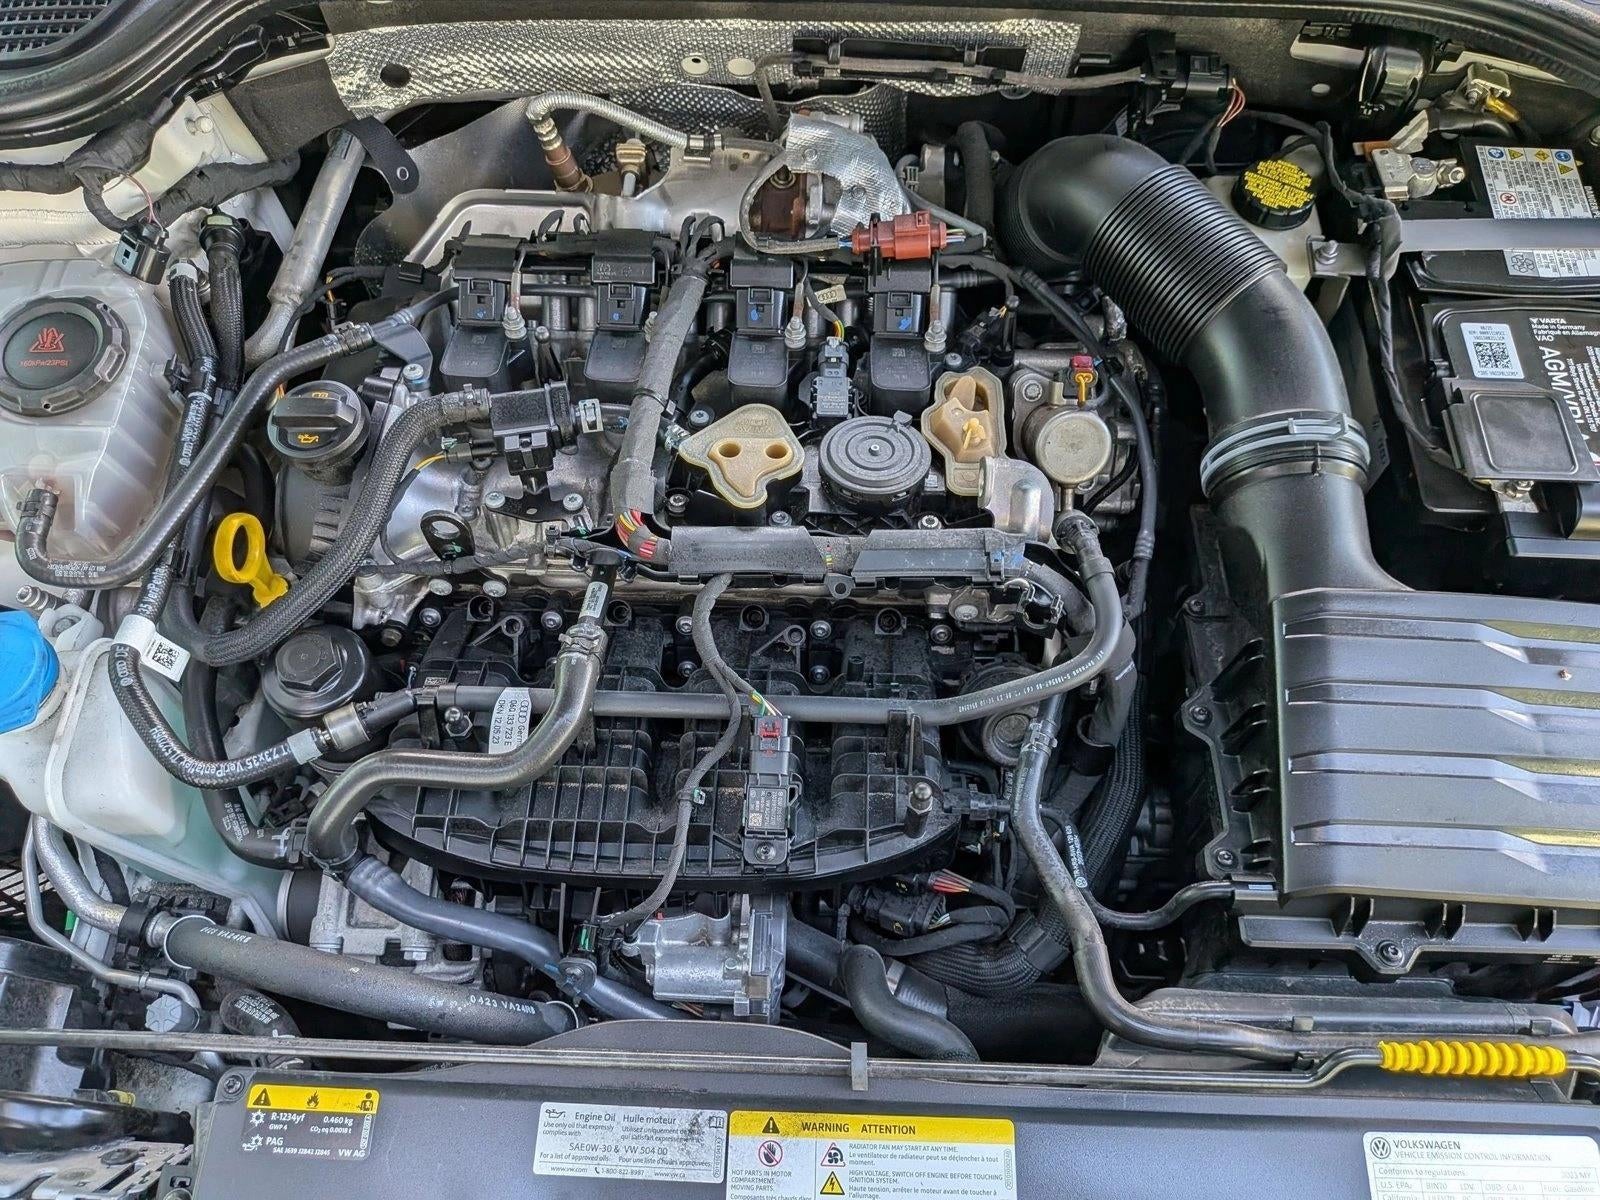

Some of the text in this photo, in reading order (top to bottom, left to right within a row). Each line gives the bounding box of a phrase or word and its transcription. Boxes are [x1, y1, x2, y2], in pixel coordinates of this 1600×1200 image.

[270, 1112, 354, 1126] R-1234yf 0.460 kg
[575, 1112, 677, 1125] Engine Oil Huile moteur
[588, 1124, 614, 1132] expressly
[644, 1127, 680, 1135] uniquement
[801, 1121, 916, 1135] WARNING ATTENTION
[542, 1129, 568, 1137] complies
[265, 1137, 284, 1146] PAG
[1393, 1139, 1461, 1150] VOLKSWAGEN
[338, 1149, 353, 1157] VW
[353, 1149, 366, 1158] AG
[613, 1145, 620, 1153] &
[624, 1145, 639, 1154] VW
[640, 1146, 656, 1155] 504
[657, 1147, 668, 1156] 00
[571, 1154, 599, 1162] approved
[1394, 1151, 1551, 1161] VEHICLE EMISSION CONTROL INFORMATION
[654, 1170, 686, 1178] www.vw.ca
[1378, 1167, 1414, 1176] Conforms
[950, 1172, 972, 1180] BEFORE
[973, 1173, 1003, 1181] TOUCHING
